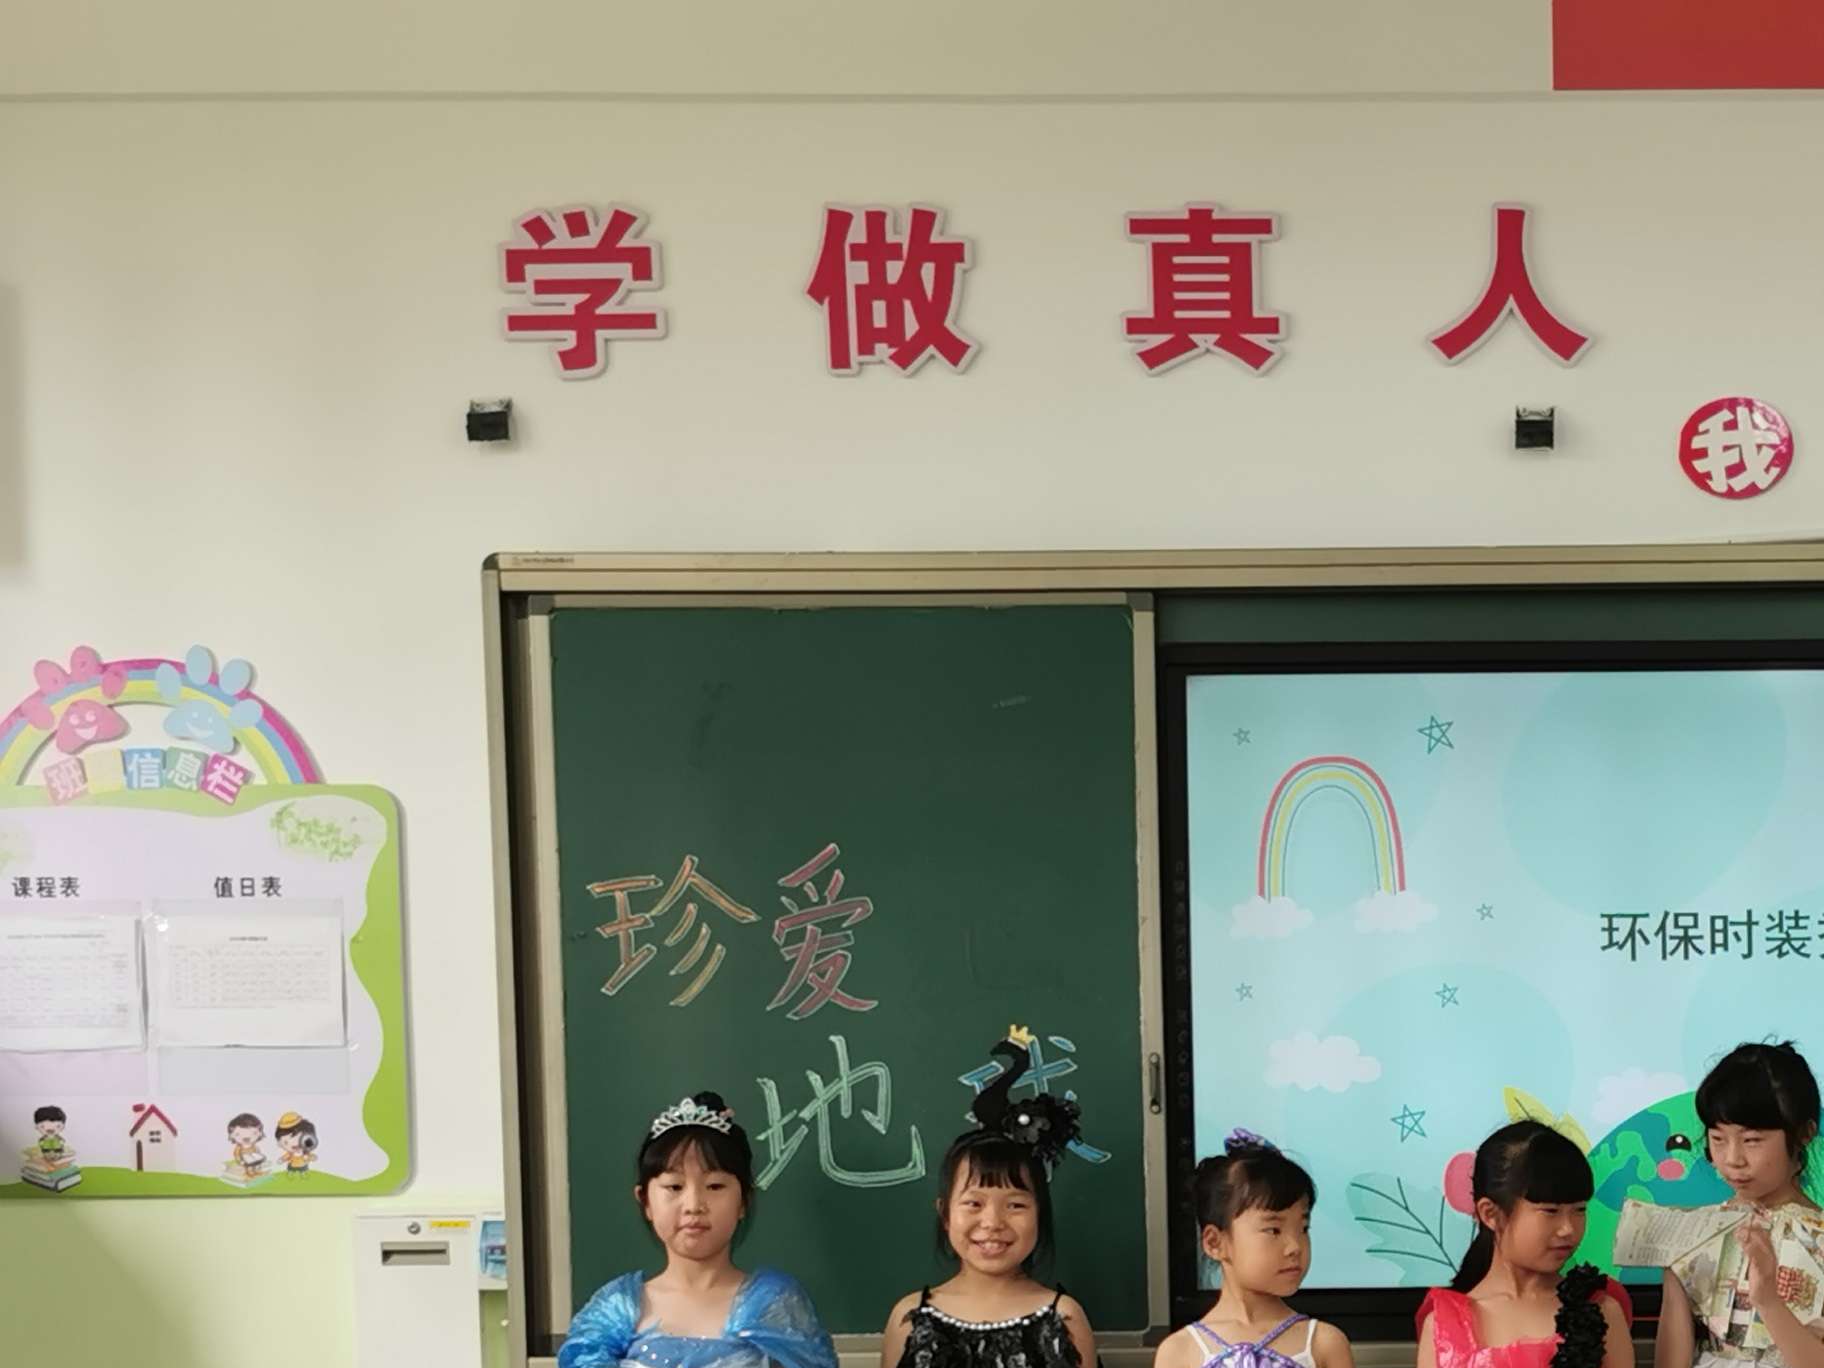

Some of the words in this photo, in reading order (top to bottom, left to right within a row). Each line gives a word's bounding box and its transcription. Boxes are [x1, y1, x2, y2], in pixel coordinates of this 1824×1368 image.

[504, 206, 1589, 372] 学做真人
[43, 750, 244, 805] 班信息栏
[12, 876, 81, 899] 课程表
[213, 876, 283, 899] 值日表
[586, 842, 877, 1021] 珍爱
